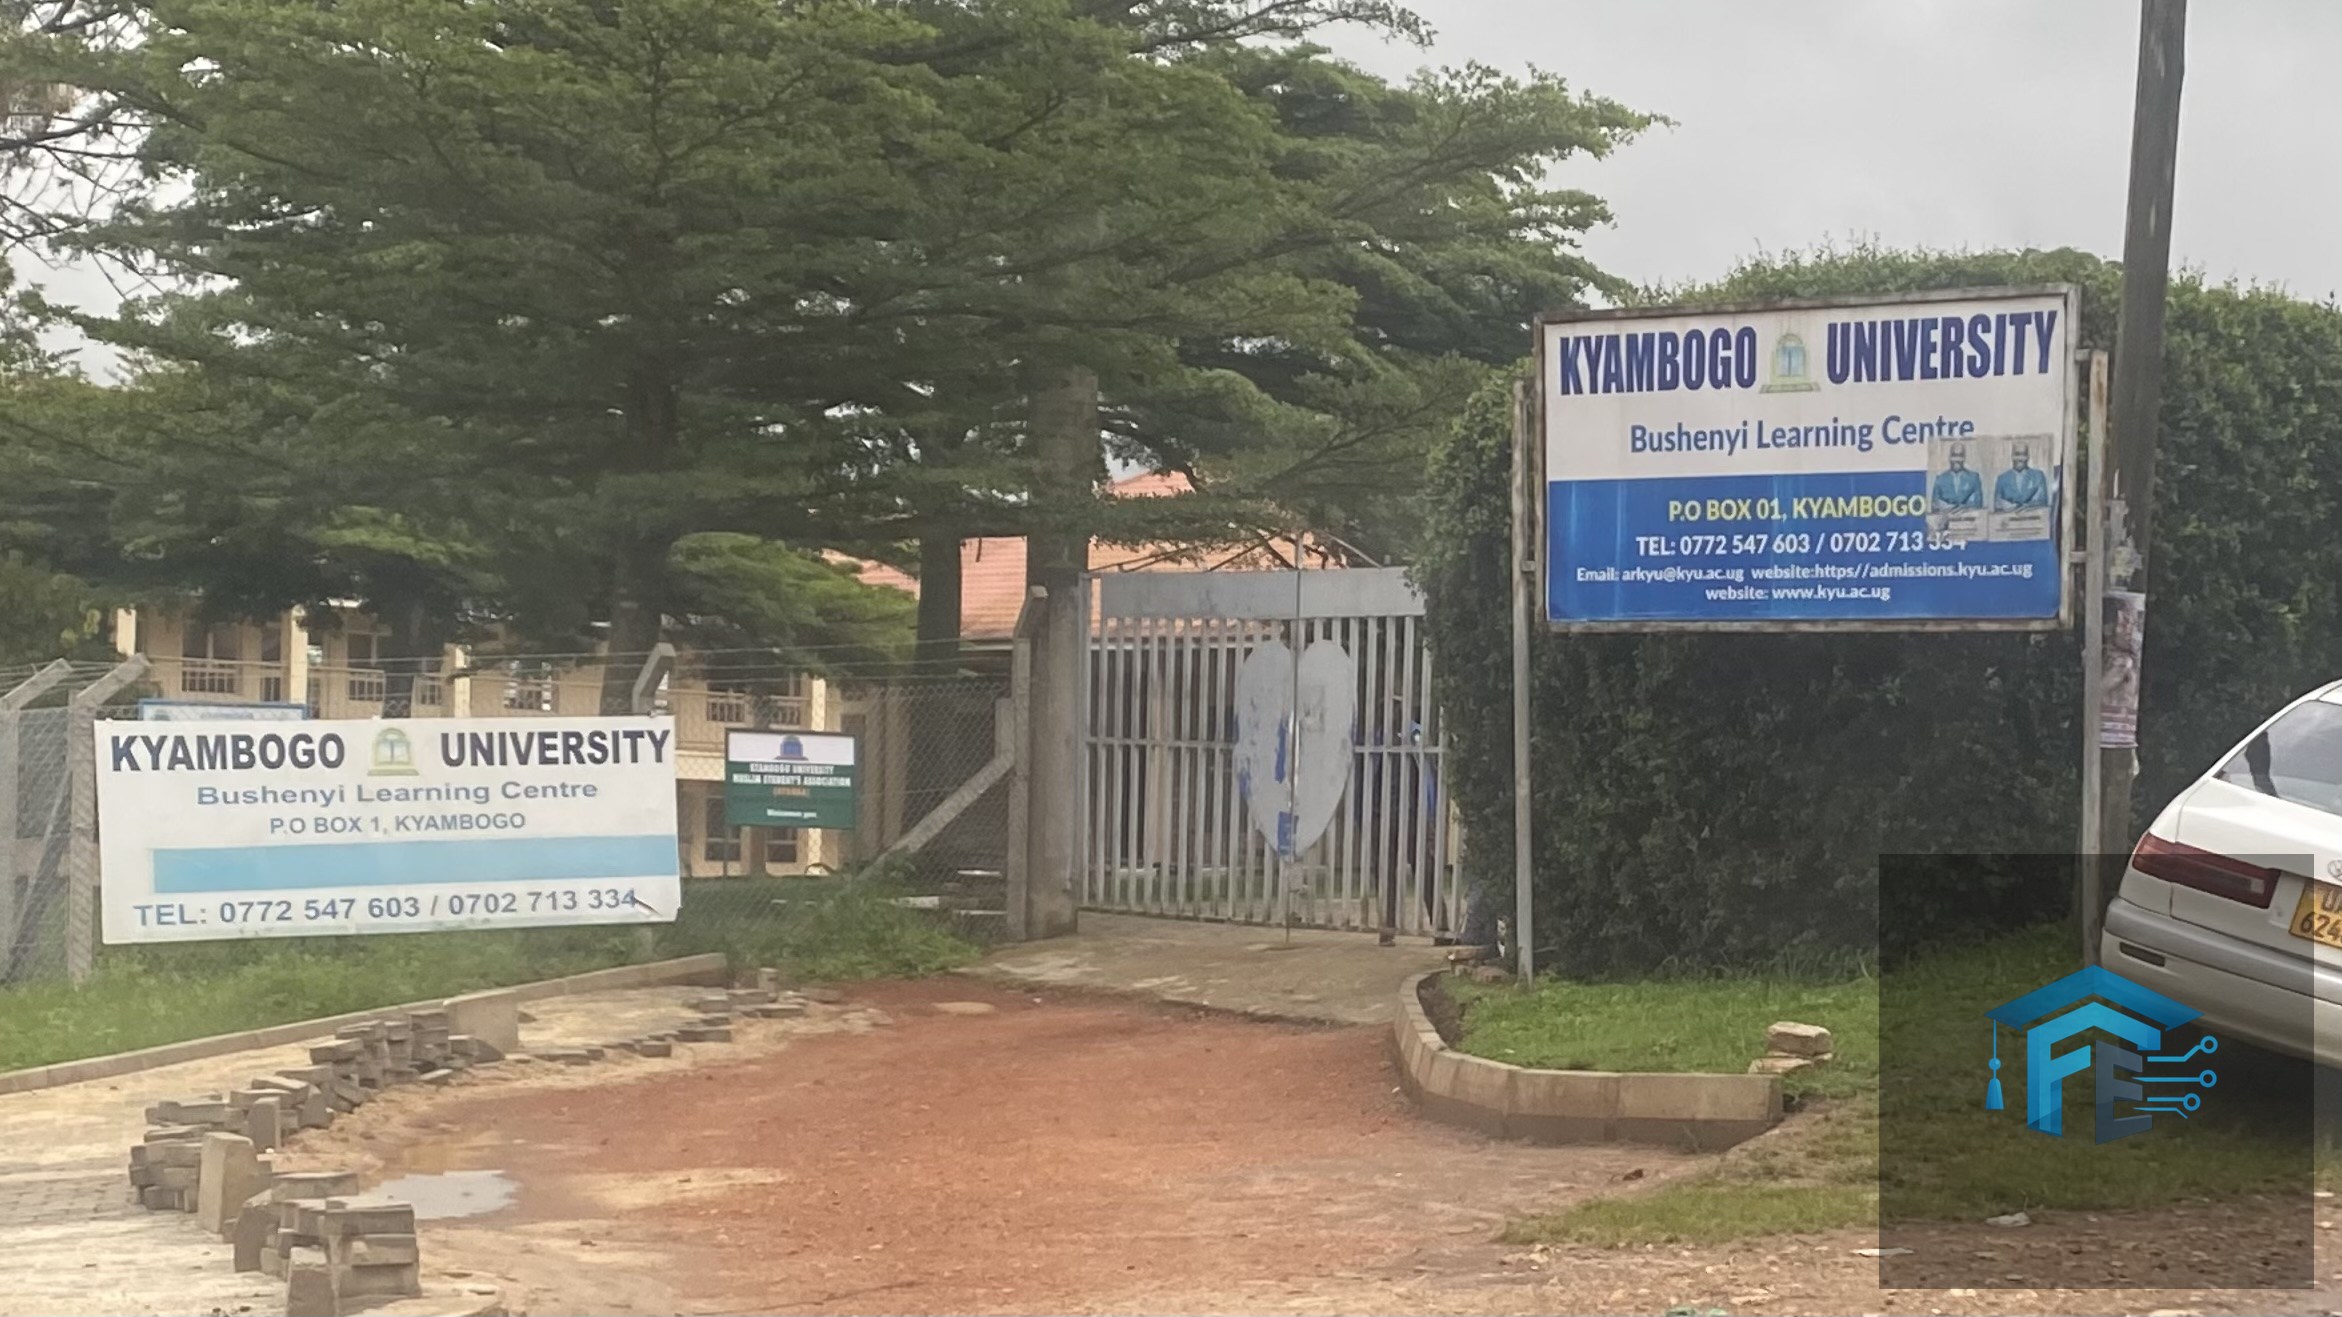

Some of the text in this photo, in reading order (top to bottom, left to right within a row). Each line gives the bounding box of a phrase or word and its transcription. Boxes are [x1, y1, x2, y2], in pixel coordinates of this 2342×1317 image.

[1560, 310, 2058, 395] KYAMBOGO UNIVERSITY
[1630, 415, 1975, 456] Bushenyi Learning Centre
[1668, 495, 1926, 523] P.O BOX 01, KYAMBOGO
[1636, 536, 1676, 556] TEL:
[1680, 535, 1727, 555] 0772
[1732, 534, 1768, 554] 547
[1773, 533, 1810, 553] 603
[1815, 532, 1825, 554] /
[1830, 532, 1881, 552] 0702
[1886, 531, 1924, 551] 713
[1576, 566, 1620, 581] Email:
[1621, 567, 1744, 583] arkyu@kyu.ac.ug
[1705, 584, 1891, 601] website: www.kyu.ac.ug
[111, 729, 671, 772] KYAMBOGO UNIVERSITY
[197, 781, 598, 807] Bushenyi Learning Centre
[270, 812, 526, 834] P.O BOX 1, KYAMBOGO
[133, 888, 636, 926] TEL: 0772 547 603 / 0702 713 334
[2301, 911, 2342, 943] 624
